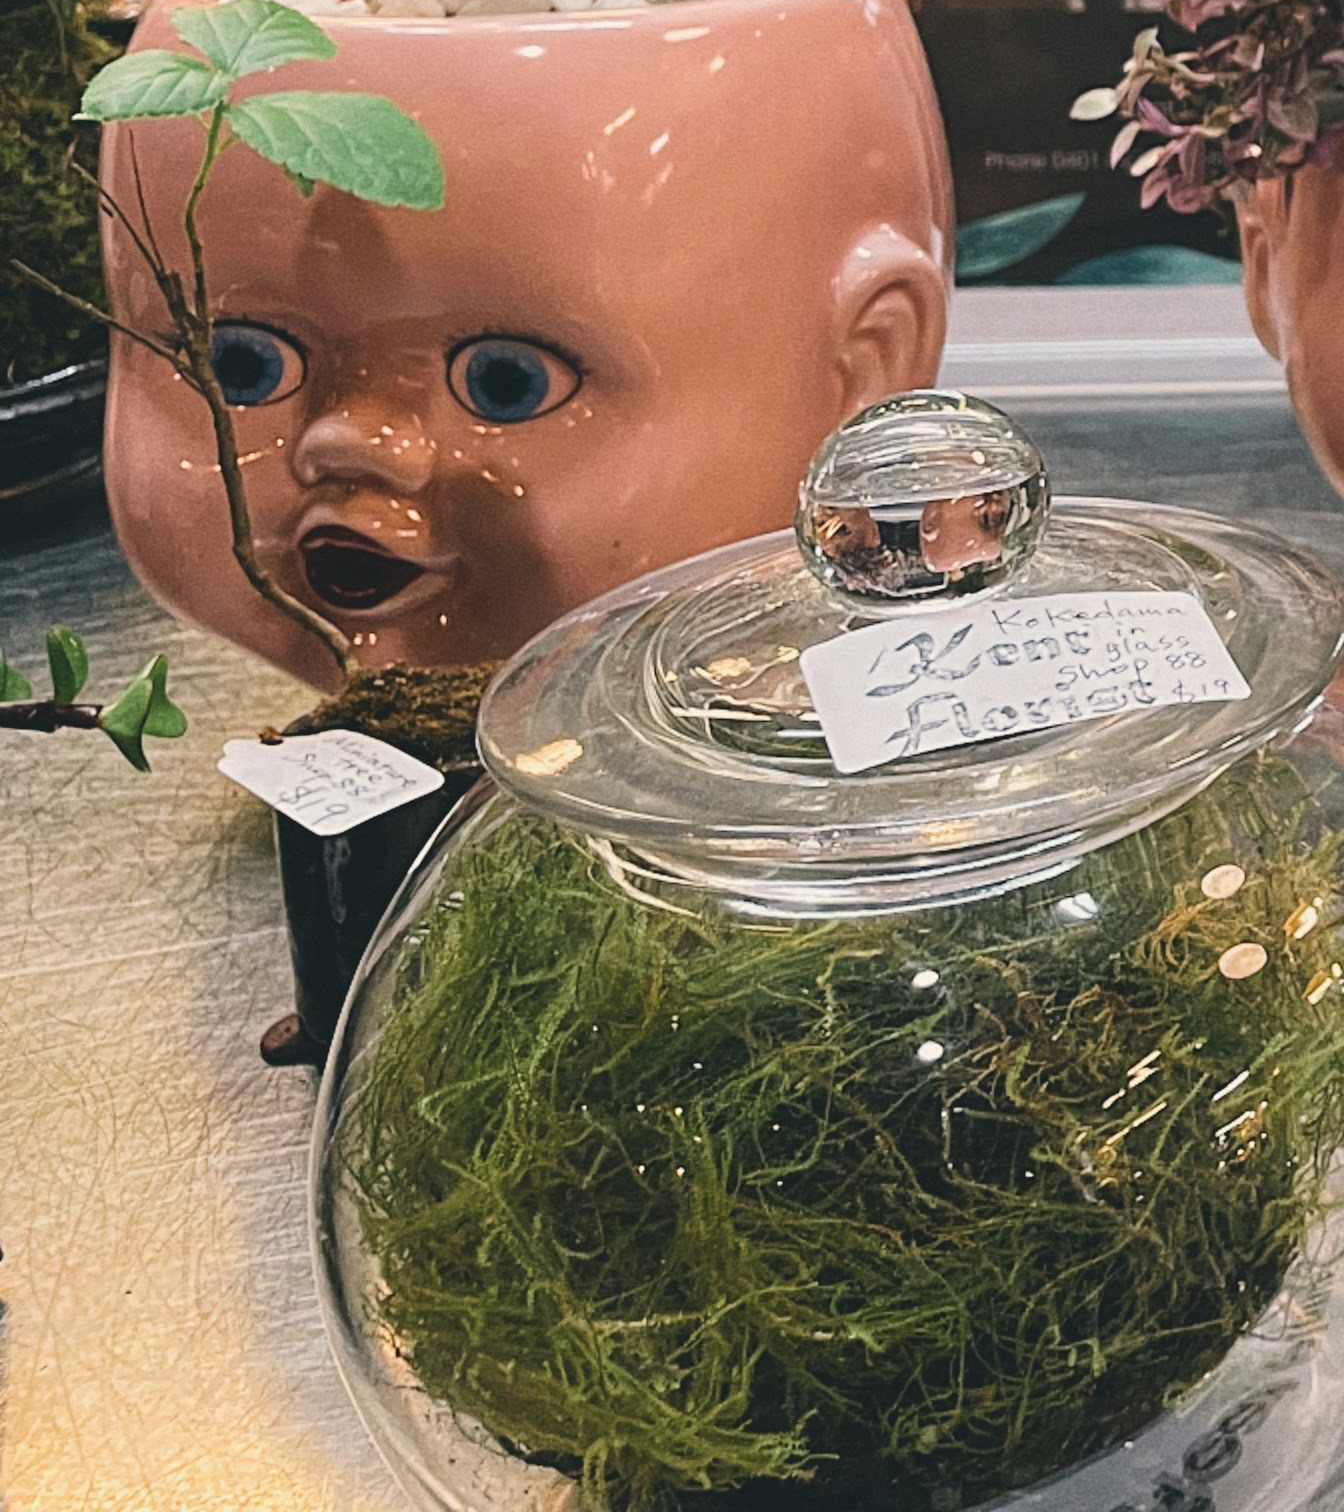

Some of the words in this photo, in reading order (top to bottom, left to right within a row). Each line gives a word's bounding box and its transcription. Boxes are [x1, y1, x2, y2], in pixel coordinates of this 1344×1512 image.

[1105, 635, 1189, 663] glass
[1166, 652, 1207, 670] 88
[274, 785, 349, 826] $19
